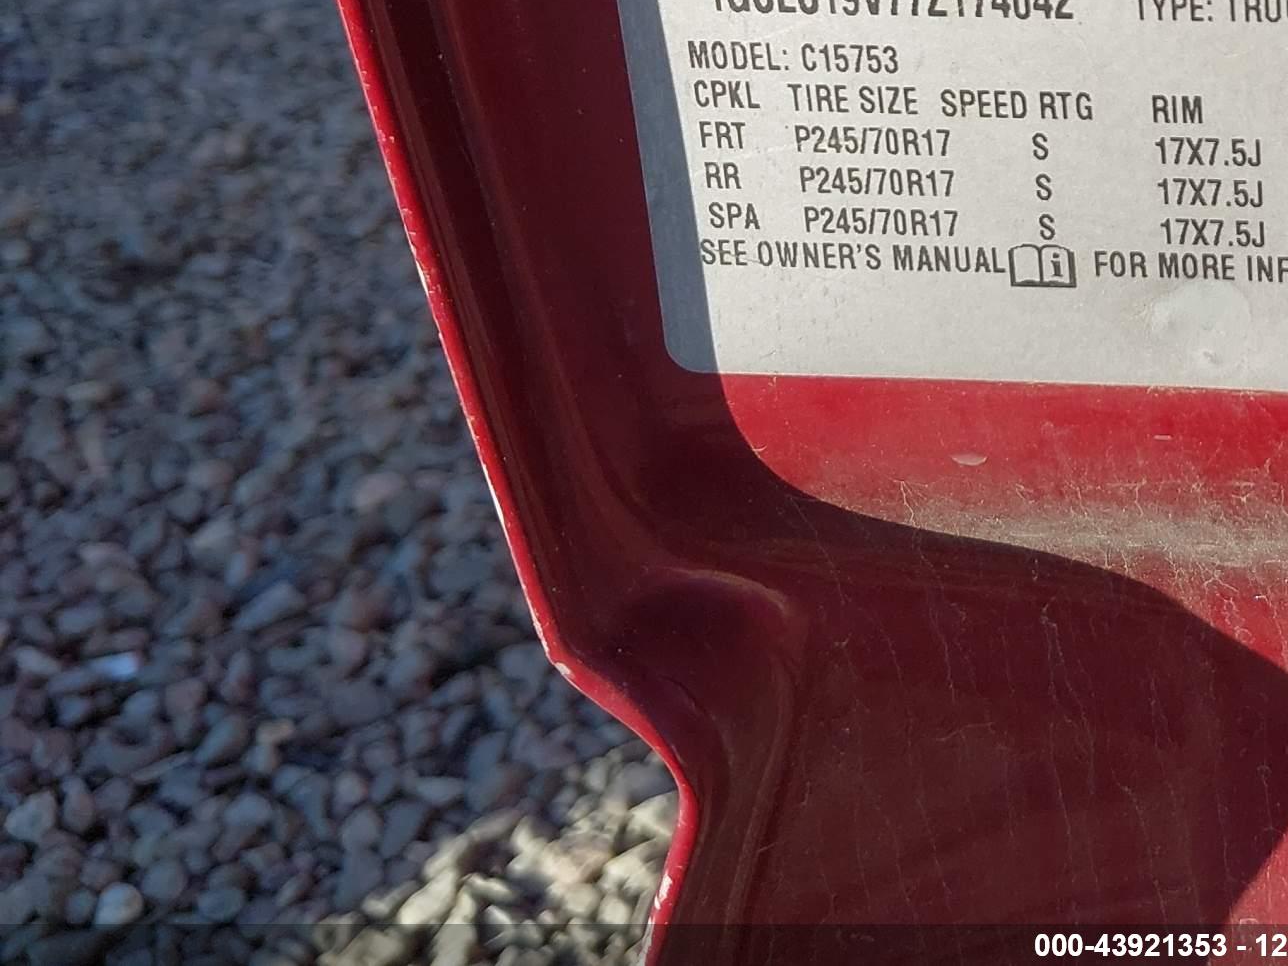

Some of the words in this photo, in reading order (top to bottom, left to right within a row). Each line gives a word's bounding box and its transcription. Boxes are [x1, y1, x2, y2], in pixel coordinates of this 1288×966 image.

[688, 41, 789, 70] MODEL:
[802, 43, 898, 74] C15753
[694, 80, 760, 108] CPKL
[787, 84, 849, 112] TIRE
[859, 86, 918, 114] SIZE
[941, 89, 1027, 118] SPEED
[1040, 92, 1092, 120] RTG
[1152, 95, 1203, 124] RIM
[699, 121, 745, 149] FRT
[795, 125, 950, 156] P245/70R17
[1032, 133, 1048, 160] S
[1155, 137, 1261, 166] 17X7.5J
[705, 162, 741, 189] RR
[800, 166, 954, 196] P245/70R17
[1036, 174, 1052, 200] S
[1158, 178, 1263, 207] 17X7.5J
[709, 202, 760, 229] SPA
[804, 207, 957, 236] P245/70R17
[1039, 214, 1055, 240] S
[1160, 218, 1264, 247] 17X7.5J
[701, 240, 747, 267] SEE
[758, 241, 881, 270] OWNER'S
[893, 245, 1006, 273] MANUAL
[1095, 251, 1147, 278] FOR
[1159, 253, 1235, 280] MORE
